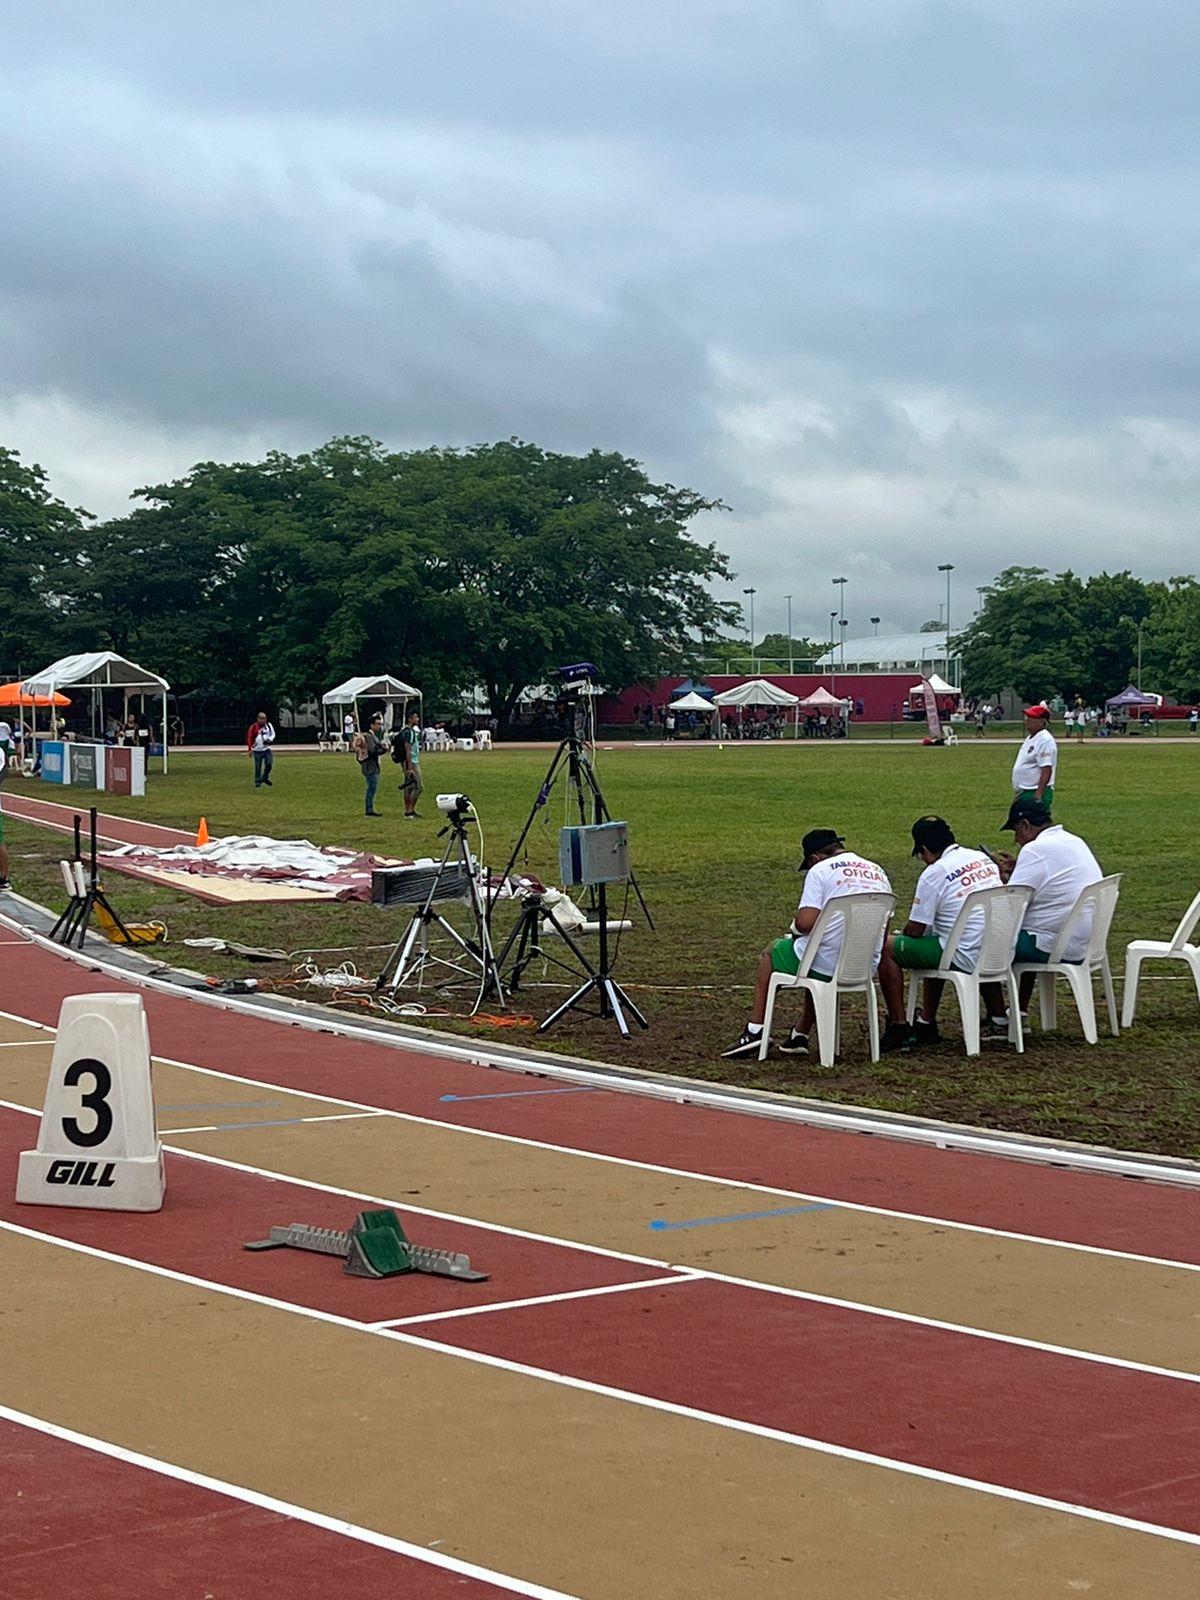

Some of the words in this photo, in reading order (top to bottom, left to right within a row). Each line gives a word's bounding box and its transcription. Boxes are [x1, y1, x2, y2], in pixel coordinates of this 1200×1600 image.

[830, 861, 870, 869] TABASCO
[843, 868, 884, 880] OFICIAL
[946, 861, 981, 881] TABASCO
[961, 867, 996, 886] OFICIAL
[62, 1059, 112, 1147] 3
[46, 1160, 116, 1187] GILL
